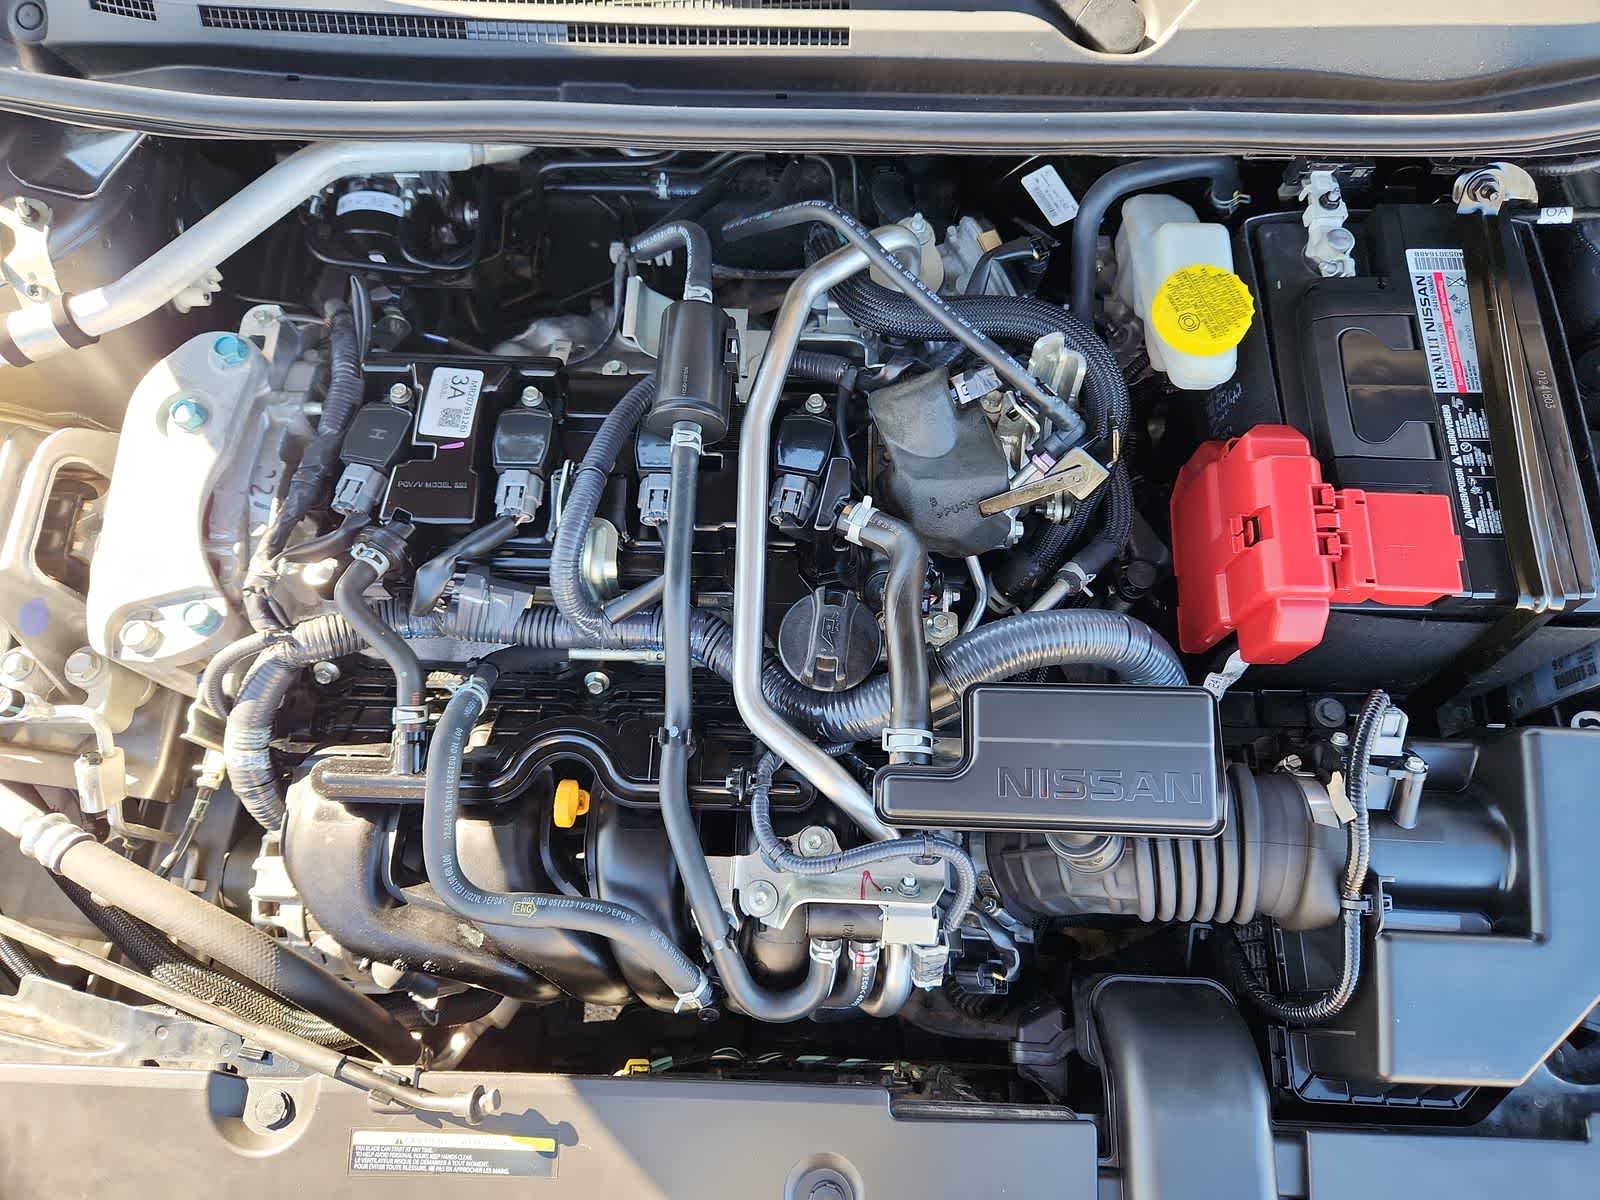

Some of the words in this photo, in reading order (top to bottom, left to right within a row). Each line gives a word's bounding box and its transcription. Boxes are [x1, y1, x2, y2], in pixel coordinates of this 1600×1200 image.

[1414, 275, 1435, 332] NISSAN
[1426, 335, 1447, 388] RENAULT
[448, 375, 469, 399] 3A
[1455, 468, 1472, 519] DANGER/POISON
[997, 767, 1203, 804] NISSAN
[515, 904, 532, 913] ENG
